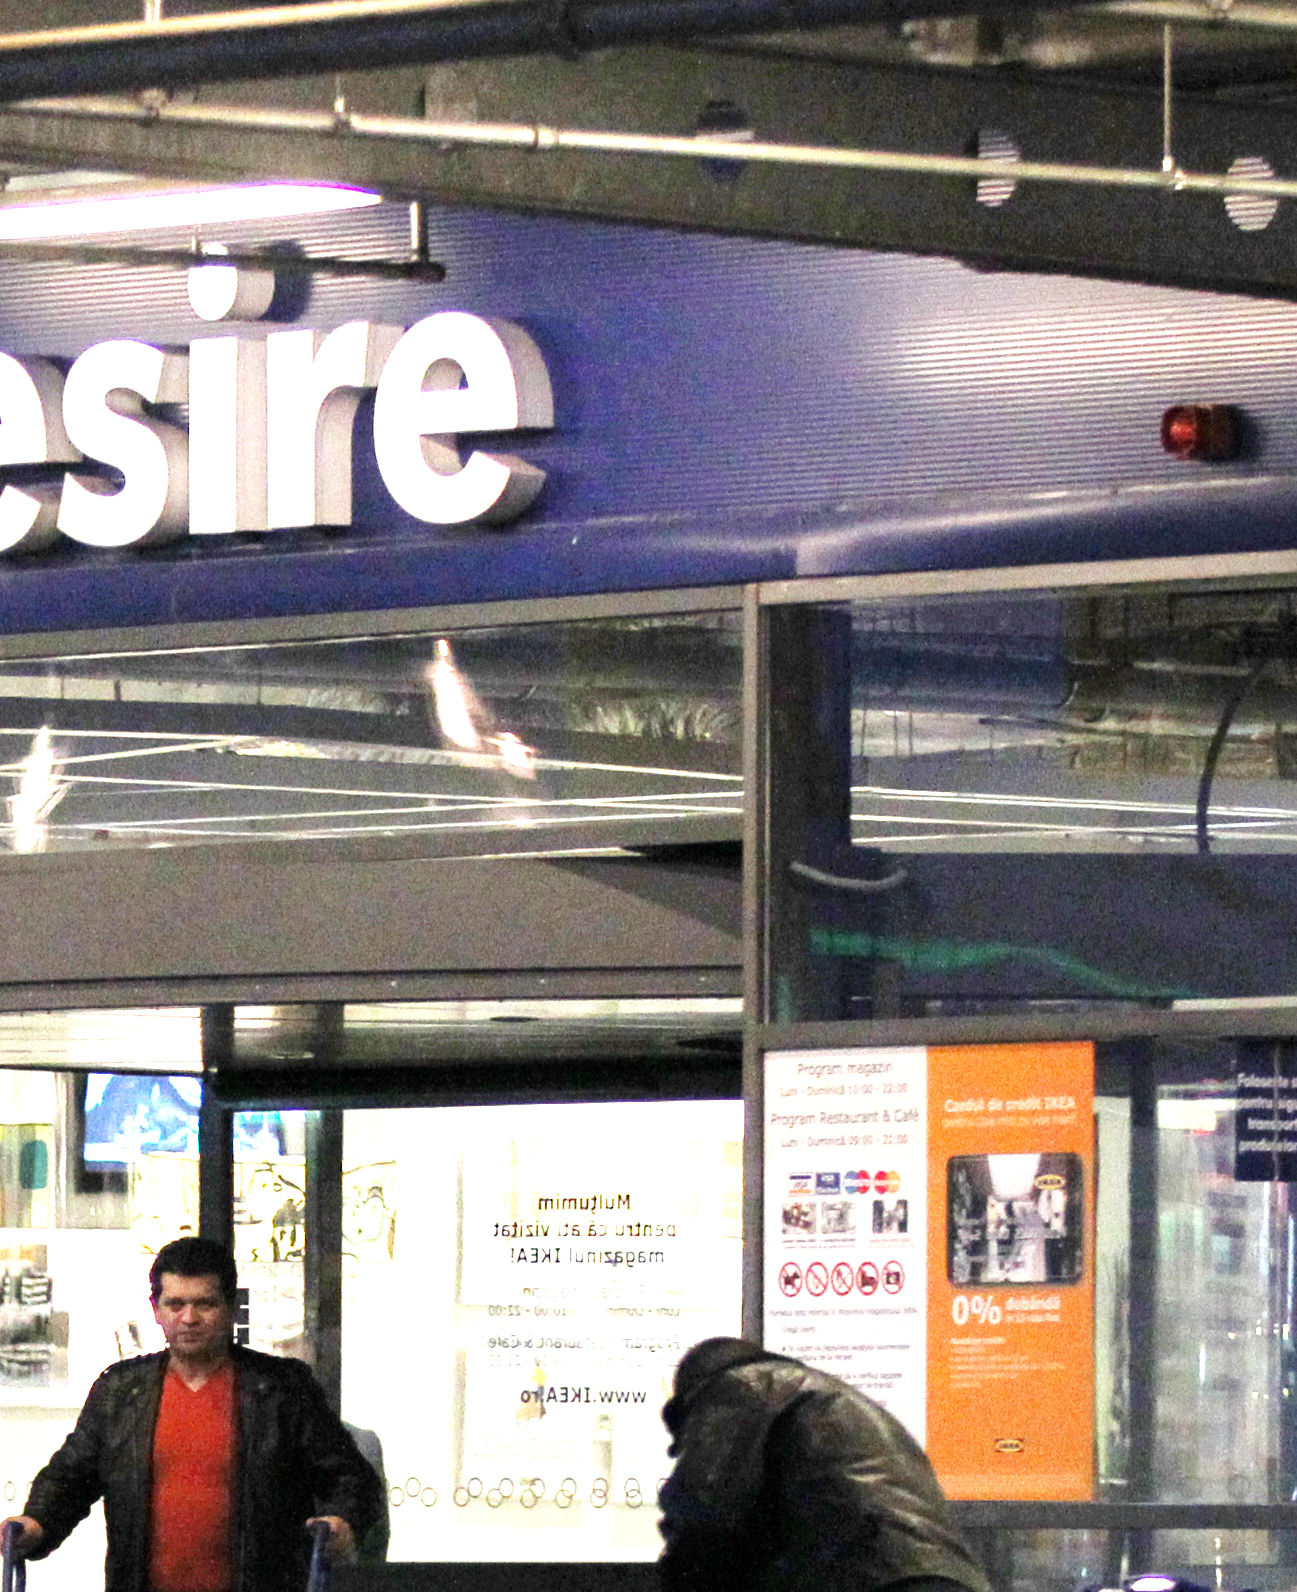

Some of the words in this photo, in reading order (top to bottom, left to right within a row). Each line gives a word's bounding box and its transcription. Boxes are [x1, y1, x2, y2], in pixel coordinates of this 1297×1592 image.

[797, 1063, 843, 1079] Program
[847, 1061, 893, 1077] magazin
[770, 1113, 815, 1128] Program
[820, 1111, 879, 1124] Restaurant
[952, 1295, 1002, 1325] 0%
